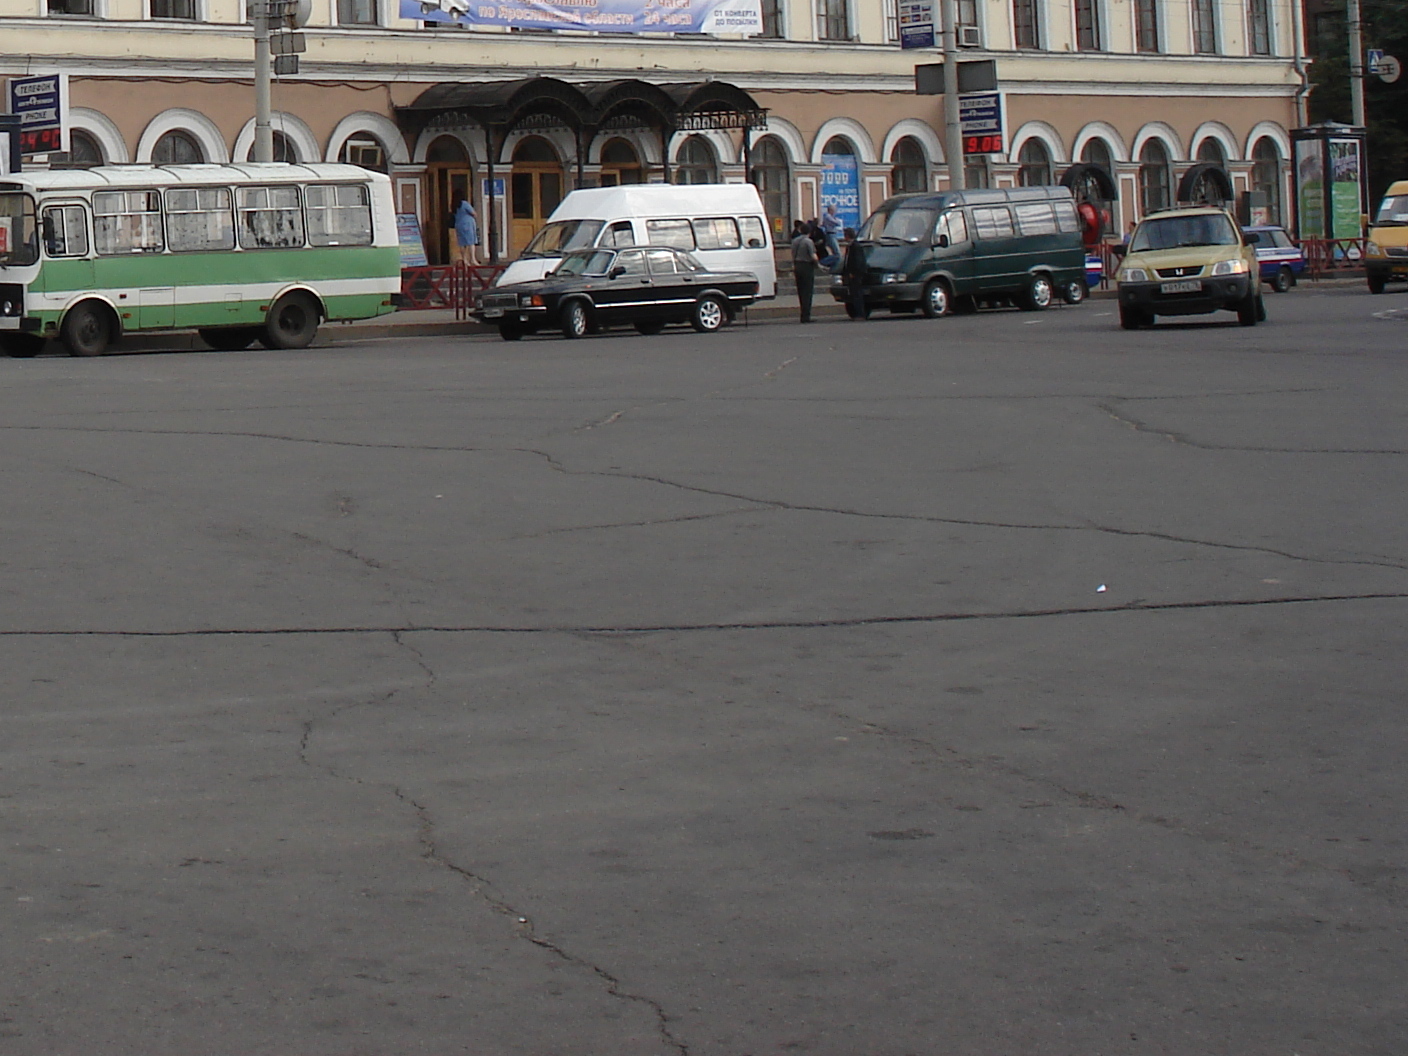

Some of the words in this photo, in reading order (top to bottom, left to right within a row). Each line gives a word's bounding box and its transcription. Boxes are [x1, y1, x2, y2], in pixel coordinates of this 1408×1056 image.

[479, 6, 495, 18] по
[584, 11, 634, 25] области
[644, 11, 659, 25] 24
[662, 13, 693, 25] часа
[20, 83, 51, 94] ТЕЛЕФОН
[960, 99, 991, 108] ТЕЛЕФОН
[25, 110, 47, 121] PHONE
